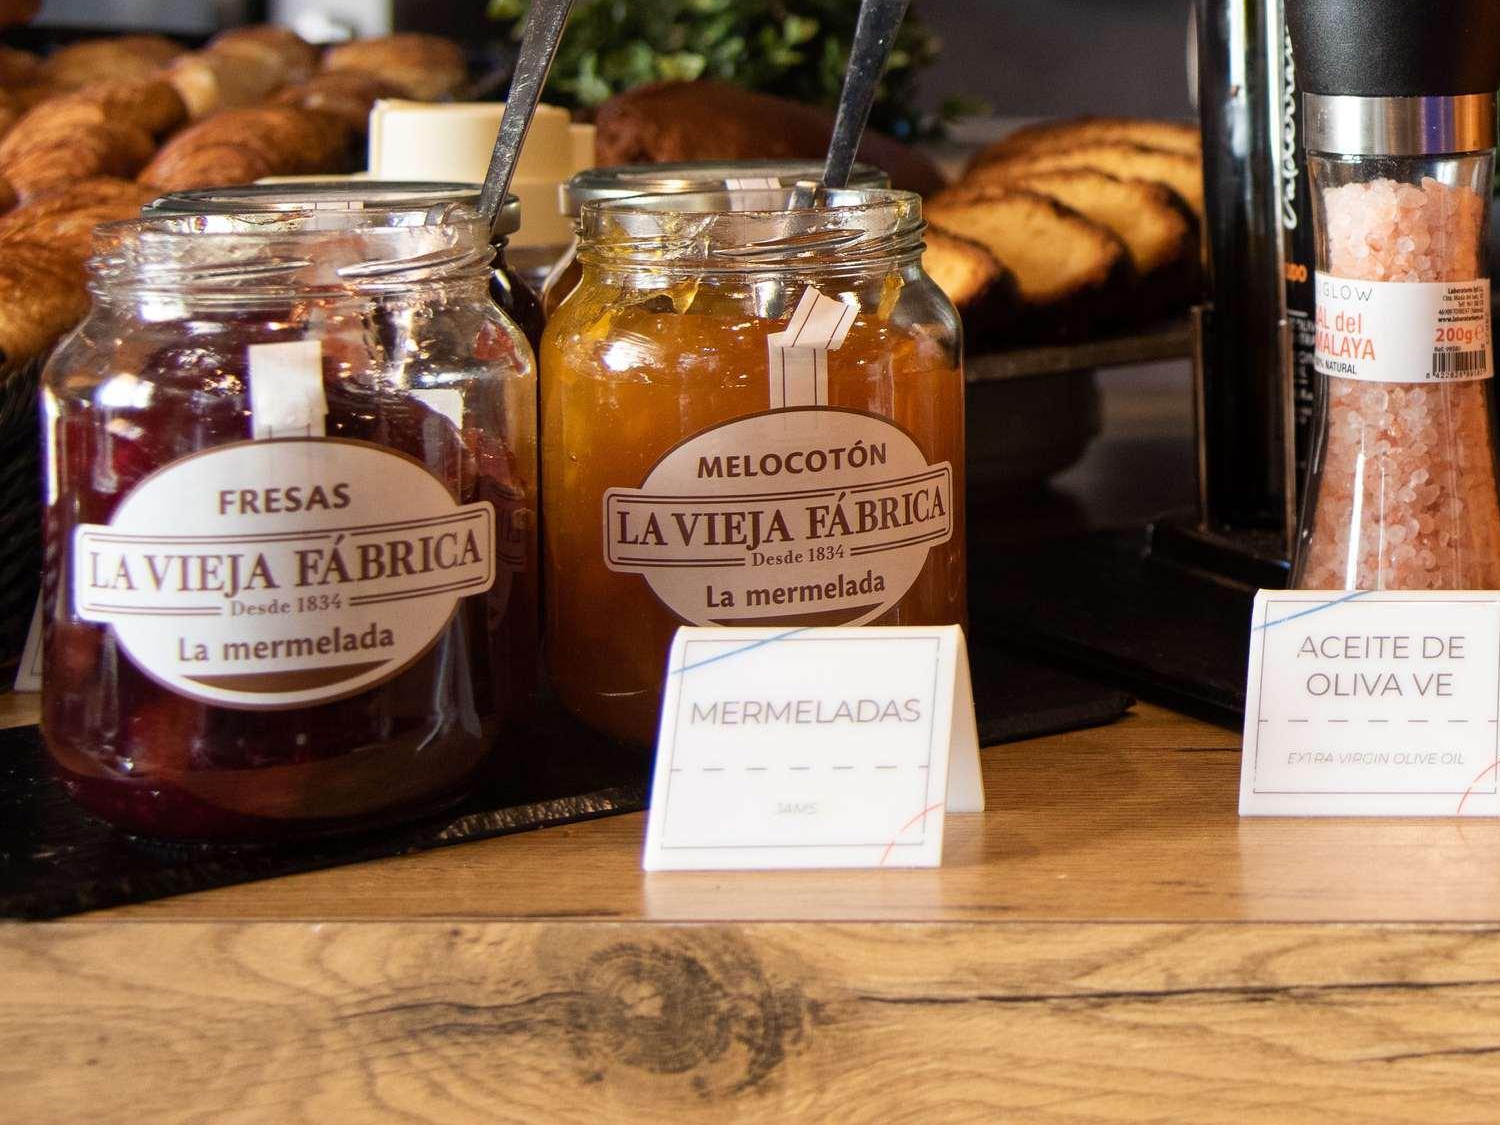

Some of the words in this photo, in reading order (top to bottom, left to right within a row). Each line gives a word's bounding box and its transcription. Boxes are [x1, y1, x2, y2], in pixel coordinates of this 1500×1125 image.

[1316, 305, 1330, 330] AL
[1336, 310, 1362, 334] del
[1435, 327, 1473, 344] 200g
[1325, 360, 1357, 375] NATURAL
[697, 441, 887, 479] MELOCOTÓN
[218, 483, 352, 516] FRESAS
[616, 509, 668, 546] LA
[670, 507, 795, 551] VIEJA
[805, 484, 946, 540] FÁBRICA
[89, 551, 138, 591] LA
[143, 551, 281, 599] VIEJA
[293, 524, 484, 588] FÁBRICA
[751, 550, 804, 568] Desde
[808, 545, 846, 563] 1834
[706, 585, 736, 609] La
[745, 569, 887, 607] mermelada
[231, 599, 291, 618] Desde
[297, 593, 343, 613] 1834
[178, 636, 209, 662] La
[223, 622, 395, 661] mermelada
[1297, 635, 1411, 660] ACEITE
[1421, 635, 1466, 660] DE
[1305, 672, 1403, 697] OLIVA
[1412, 672, 1454, 697] VE
[690, 698, 922, 726] MERMELADAS
[1287, 752, 1335, 765] EXTRA
[1338, 752, 1391, 765] VIRGIN
[1394, 752, 1438, 765] OLIVE
[1440, 752, 1465, 765] OIL
